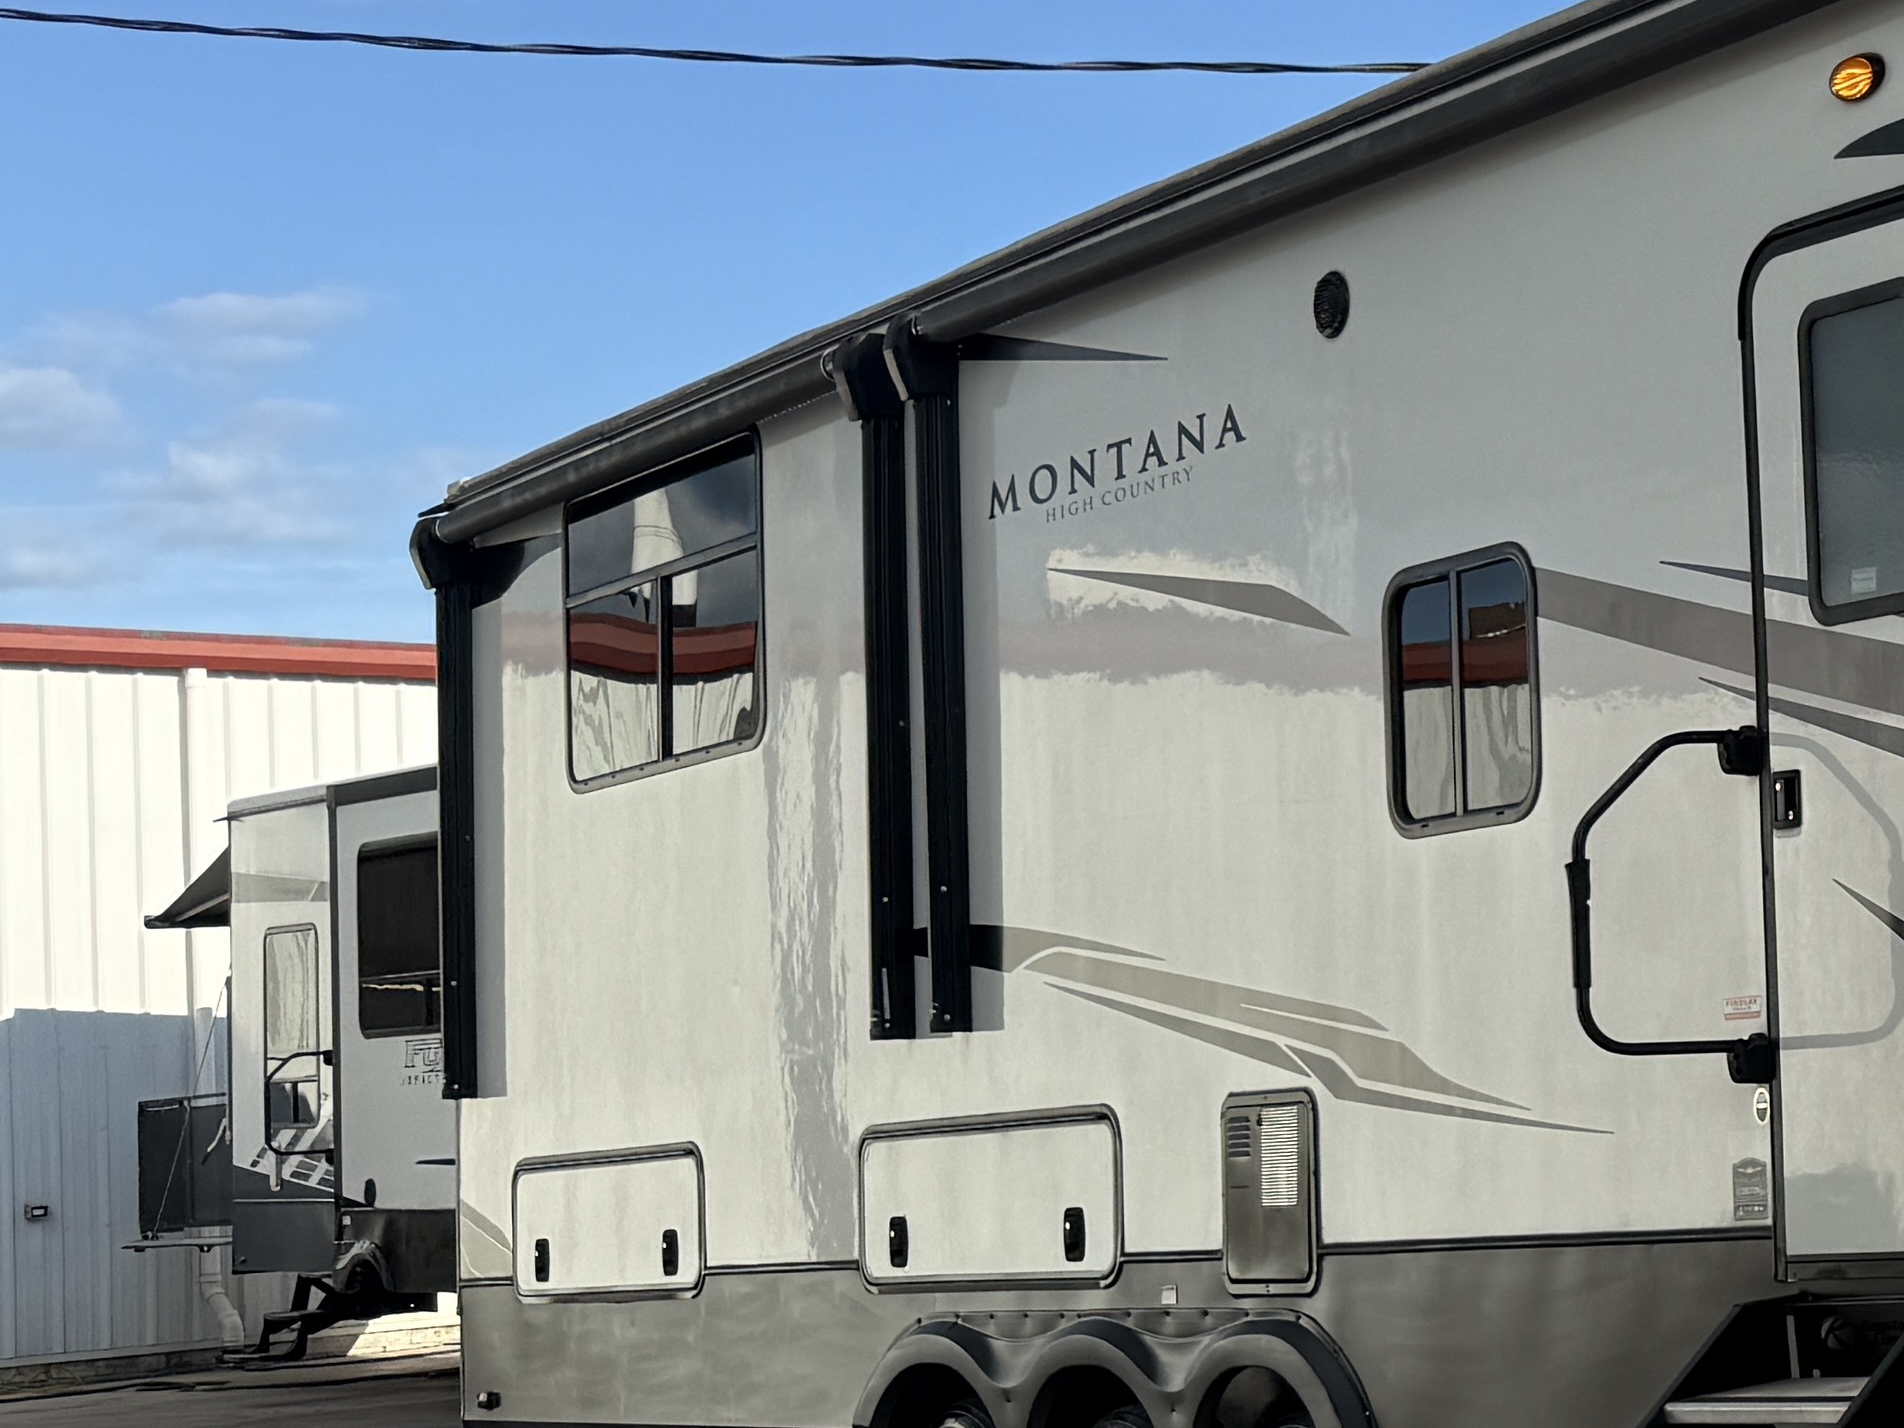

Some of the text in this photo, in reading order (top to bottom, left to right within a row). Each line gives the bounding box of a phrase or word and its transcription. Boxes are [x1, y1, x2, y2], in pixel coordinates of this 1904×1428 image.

[988, 403, 1247, 520] MONTANA
[1045, 466, 1193, 523] HIGH COUNTRY
